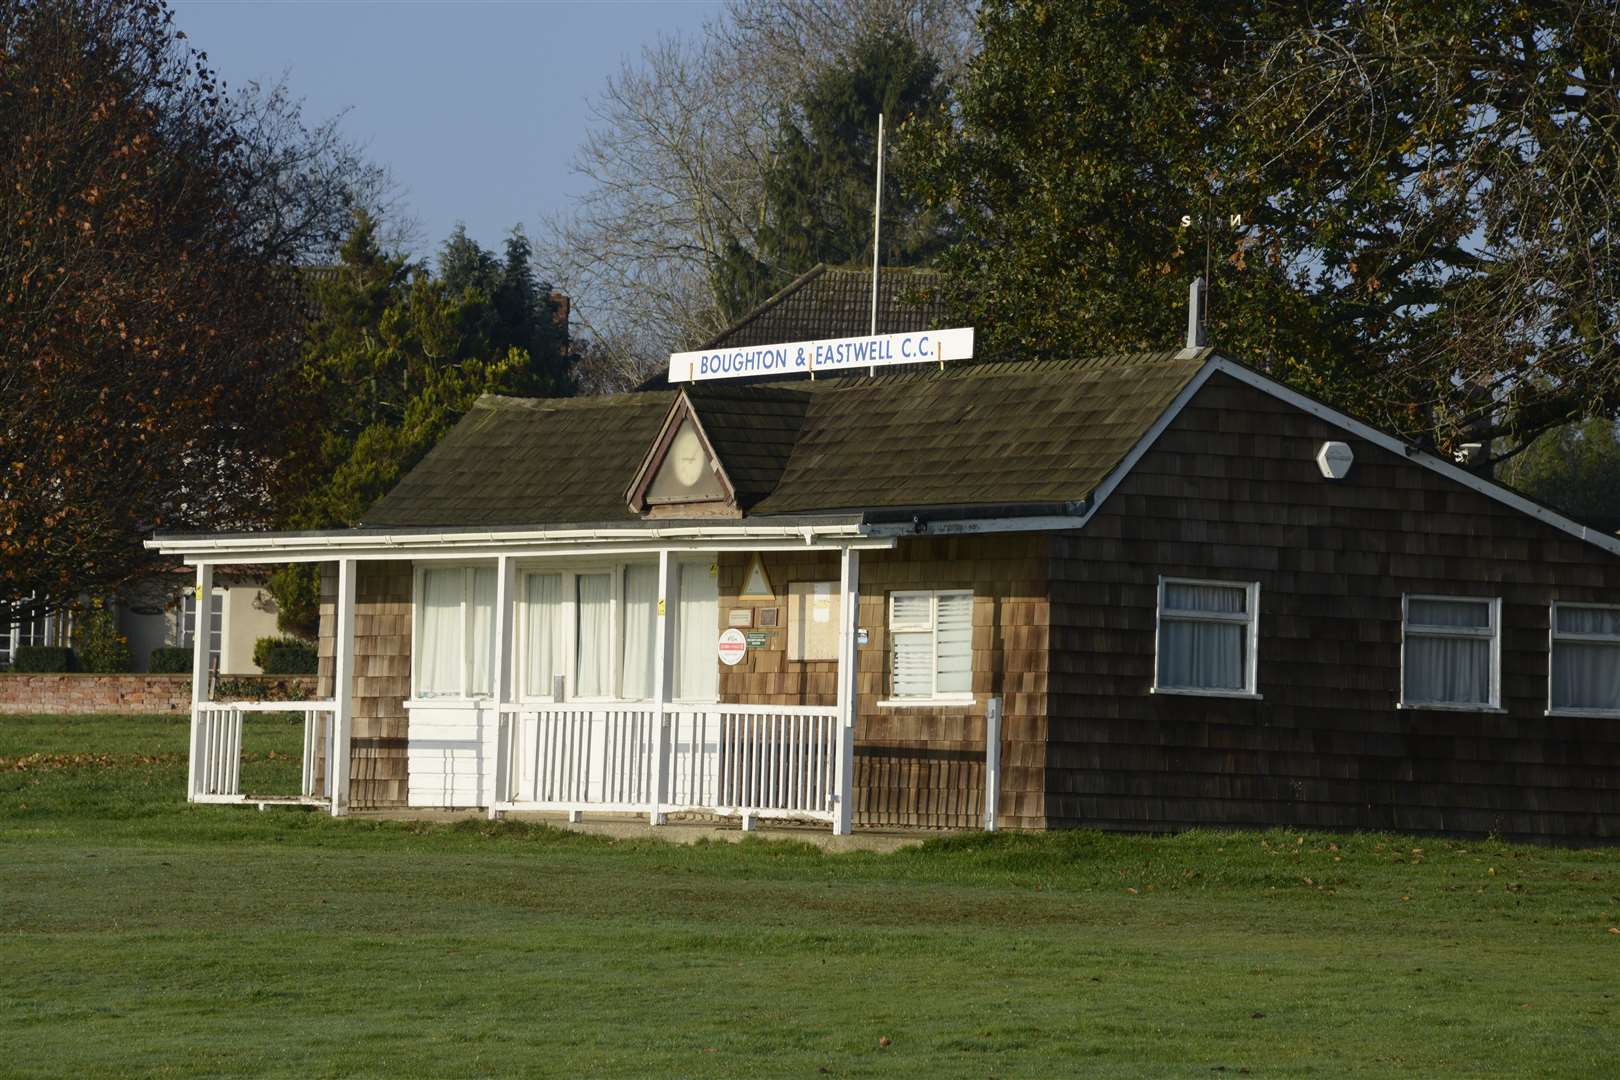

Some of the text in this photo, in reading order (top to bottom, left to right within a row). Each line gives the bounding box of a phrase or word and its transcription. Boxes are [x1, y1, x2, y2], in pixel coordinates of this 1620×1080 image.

[1181, 215, 1191, 227] S
[700, 337, 934, 374] BOUGHTON & EASTWELL C.C.
